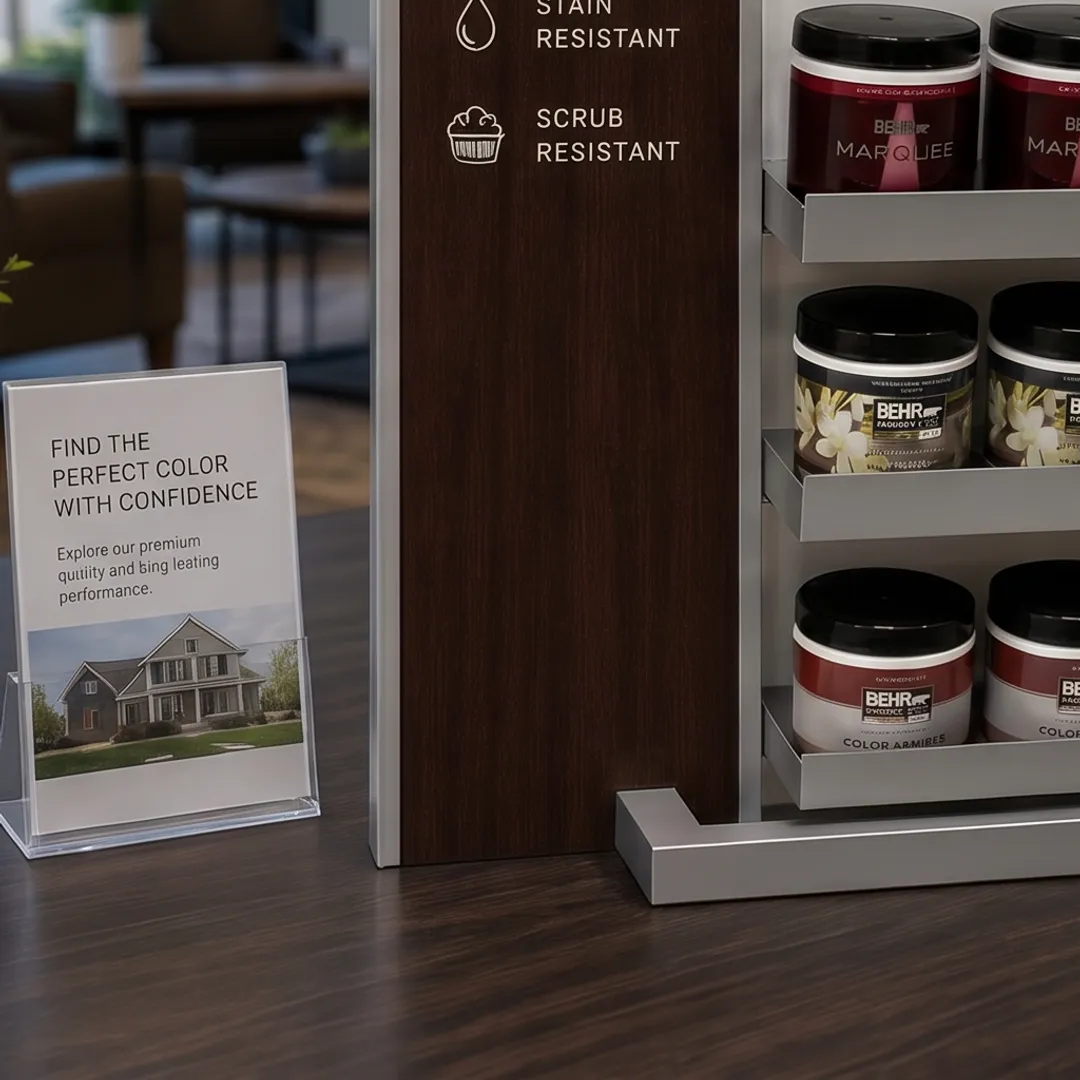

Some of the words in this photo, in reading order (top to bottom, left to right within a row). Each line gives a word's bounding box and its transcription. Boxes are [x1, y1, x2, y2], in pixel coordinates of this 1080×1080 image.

[537, 28, 681, 48] RESISTANT
[537, 108, 623, 128] SCRUB
[537, 141, 681, 162] RESISTANT
[836, 140, 954, 162] MARQUEE
[877, 402, 923, 420] BEHR
[51, 436, 101, 458] FIND
[107, 432, 150, 453] THE
[53, 461, 150, 488] PERFECT
[156, 454, 229, 478] COLOR
[54, 495, 112, 517] WITH
[119, 480, 258, 512] CONFIDENCE
[57, 543, 109, 562] Explore
[112, 542, 136, 556] our
[139, 536, 201, 556] premium
[109, 561, 135, 577] and
[173, 555, 220, 570] leating
[59, 584, 153, 607] performance.
[866, 691, 911, 707] BEHR
[843, 738, 889, 750] COLOR
